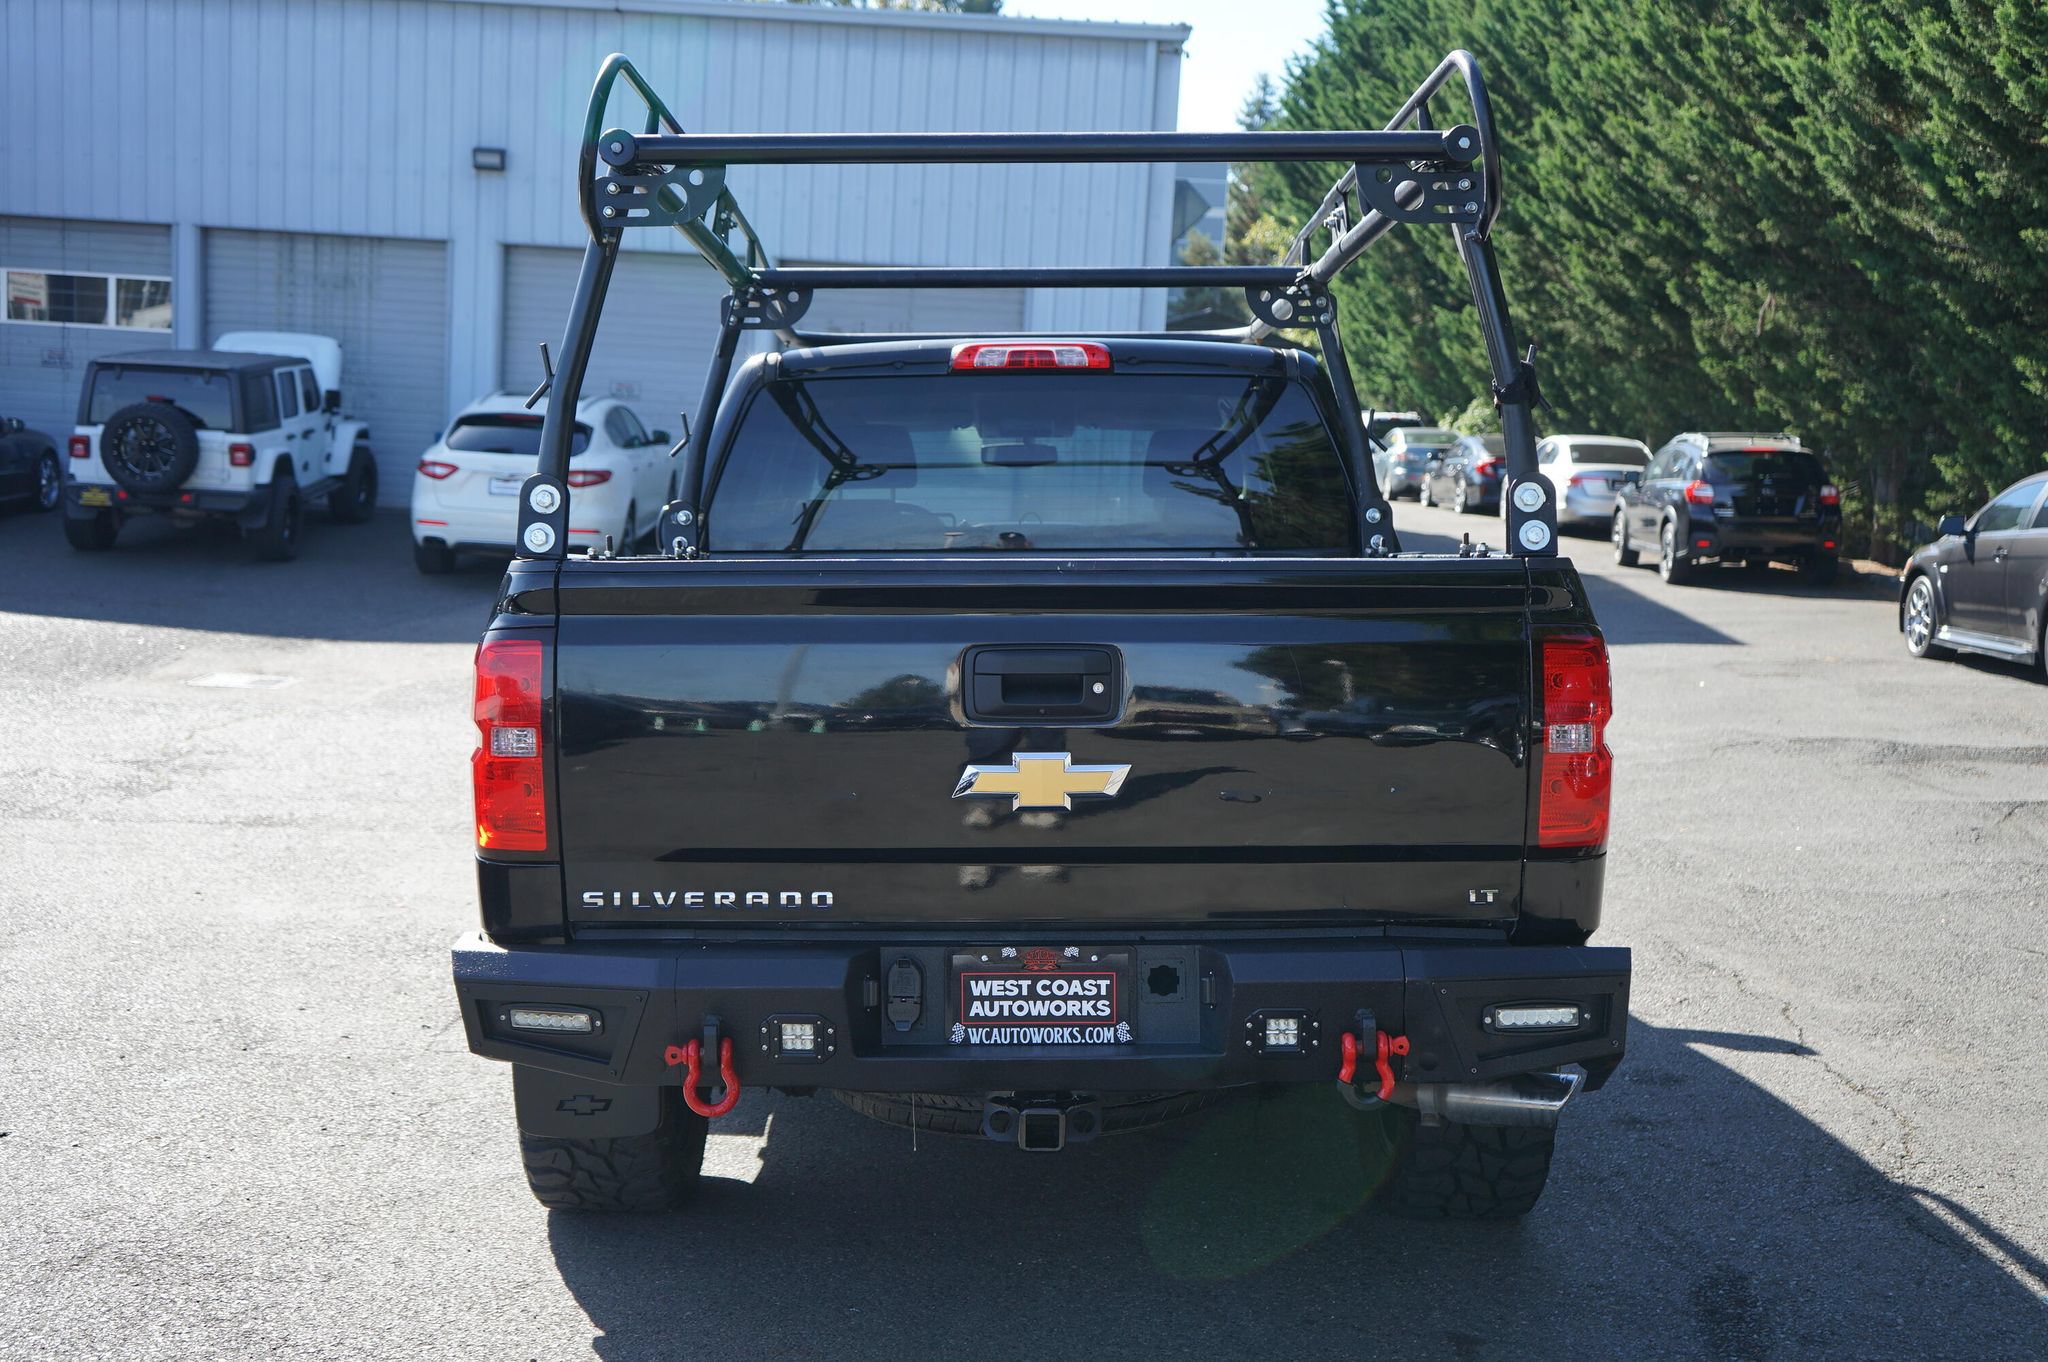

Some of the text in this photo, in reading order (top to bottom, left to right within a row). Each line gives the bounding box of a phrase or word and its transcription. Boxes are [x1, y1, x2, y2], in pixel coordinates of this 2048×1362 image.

[582, 891, 834, 909] SILVERADO
[1469, 889, 1499, 904] LT
[970, 979, 1111, 996] WEST COAST
[969, 1000, 1111, 1017] AUTOWORKS
[967, 1027, 1115, 1044] WCAUTOWORKS.COM
